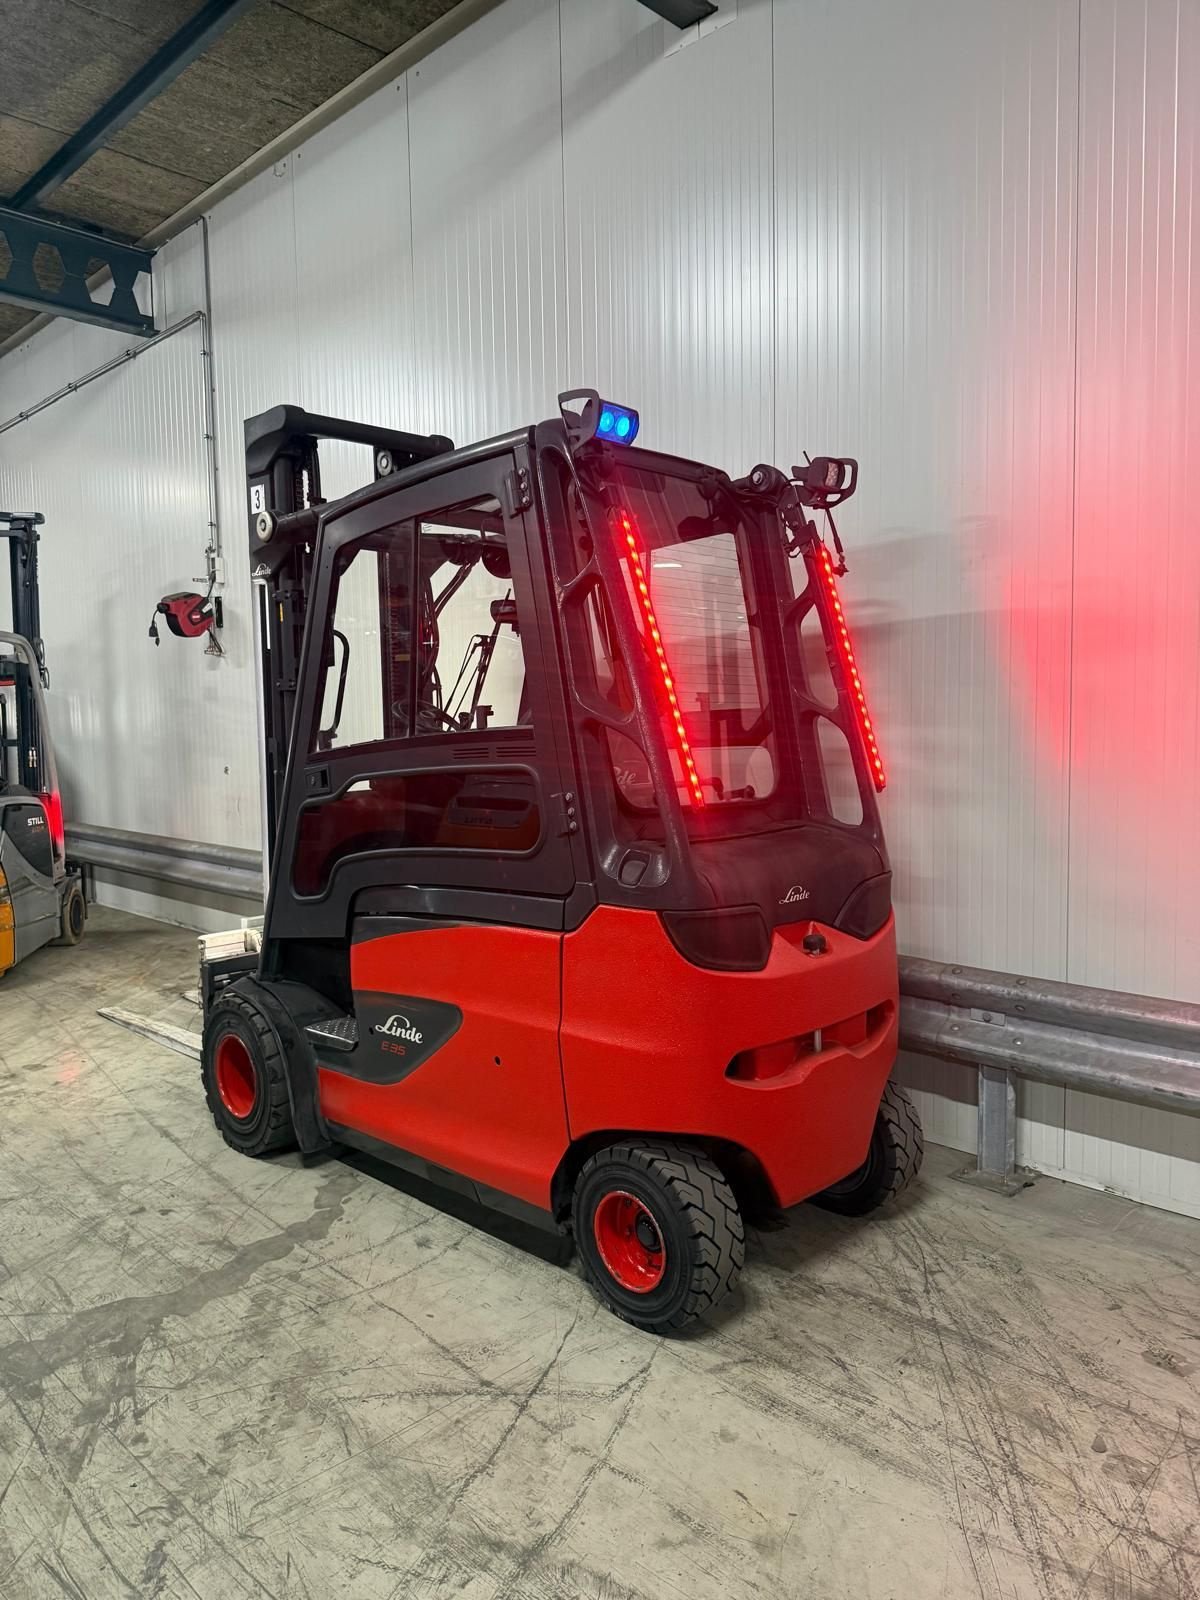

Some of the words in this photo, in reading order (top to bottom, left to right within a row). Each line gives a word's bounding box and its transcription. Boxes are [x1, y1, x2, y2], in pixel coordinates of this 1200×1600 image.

[255, 489, 261, 510] 3
[27, 816, 45, 826] STILL
[778, 885, 810, 905] Linde
[374, 1014, 424, 1044] Linde
